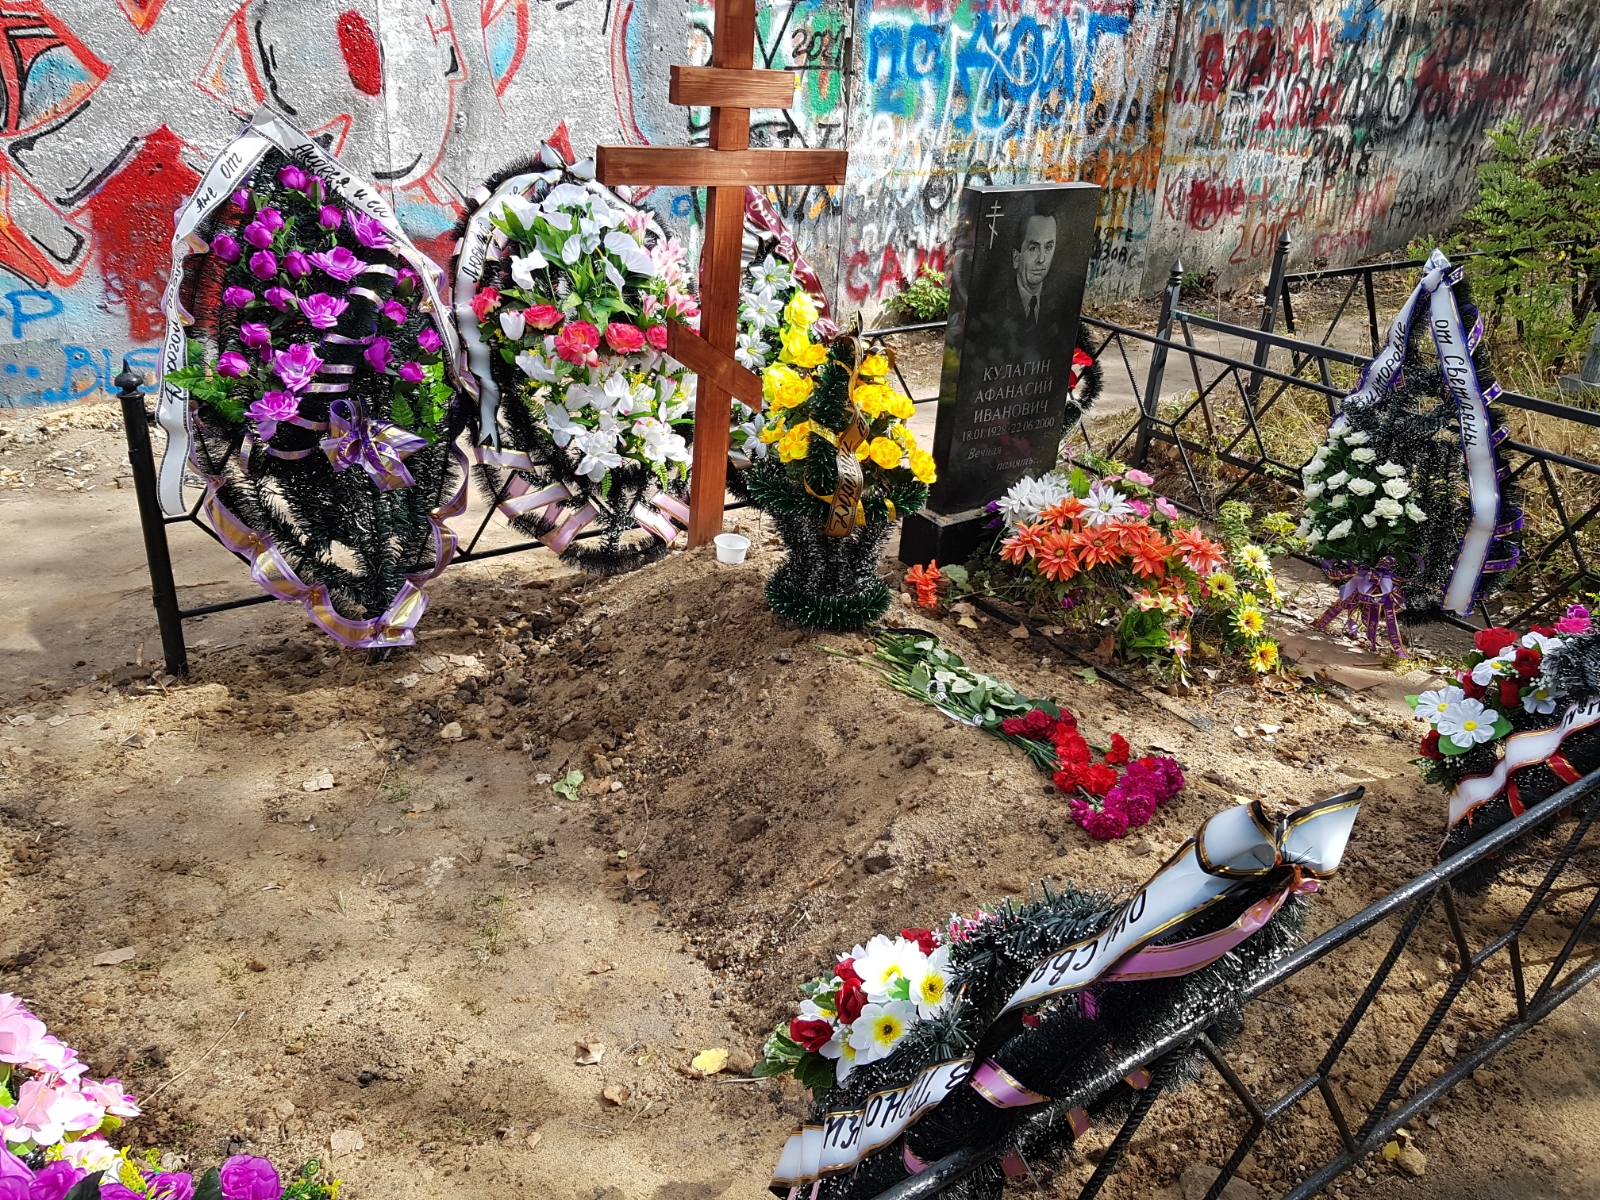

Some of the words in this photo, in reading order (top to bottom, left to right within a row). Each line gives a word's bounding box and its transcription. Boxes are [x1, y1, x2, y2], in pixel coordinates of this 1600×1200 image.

[983, 359, 1051, 381] КУЛАГИН
[974, 376, 1053, 403] АФАНАСИЙ
[973, 400, 1049, 423] ИВАНОВИЧ
[967, 446, 1003, 460] Вечная
